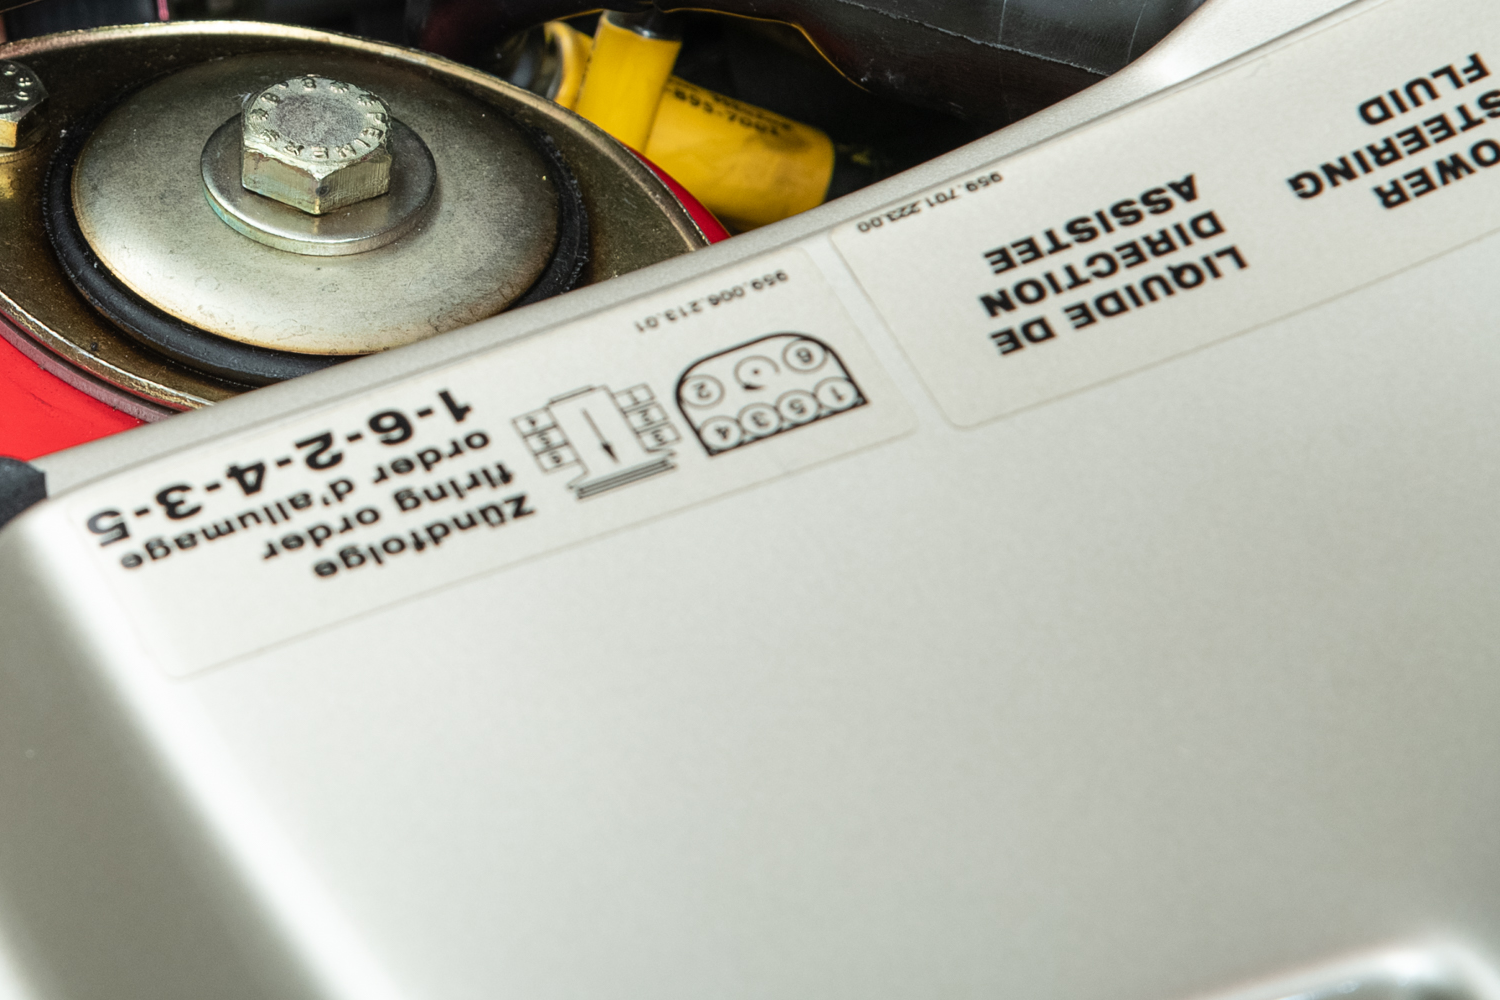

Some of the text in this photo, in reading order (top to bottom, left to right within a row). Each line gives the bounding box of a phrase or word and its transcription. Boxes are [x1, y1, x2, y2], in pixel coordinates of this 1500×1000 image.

[1358, 53, 1492, 126] FLUID
[1287, 90, 1500, 200] STEERING
[858, 172, 1003, 233] 959.701.223.00
[983, 173, 1200, 276] ASSISTEE
[979, 210, 1227, 320] DIRECTION
[990, 246, 1250, 356] LIQUIDE DE
[693, 347, 814, 400] 6 2
[715, 386, 846, 442] 1 5 3 4
[86, 389, 474, 548] 1-6-2-4-3-5
[120, 430, 492, 570] order d'allumage
[262, 462, 515, 561] firing order
[312, 492, 536, 579] Zündfolge
